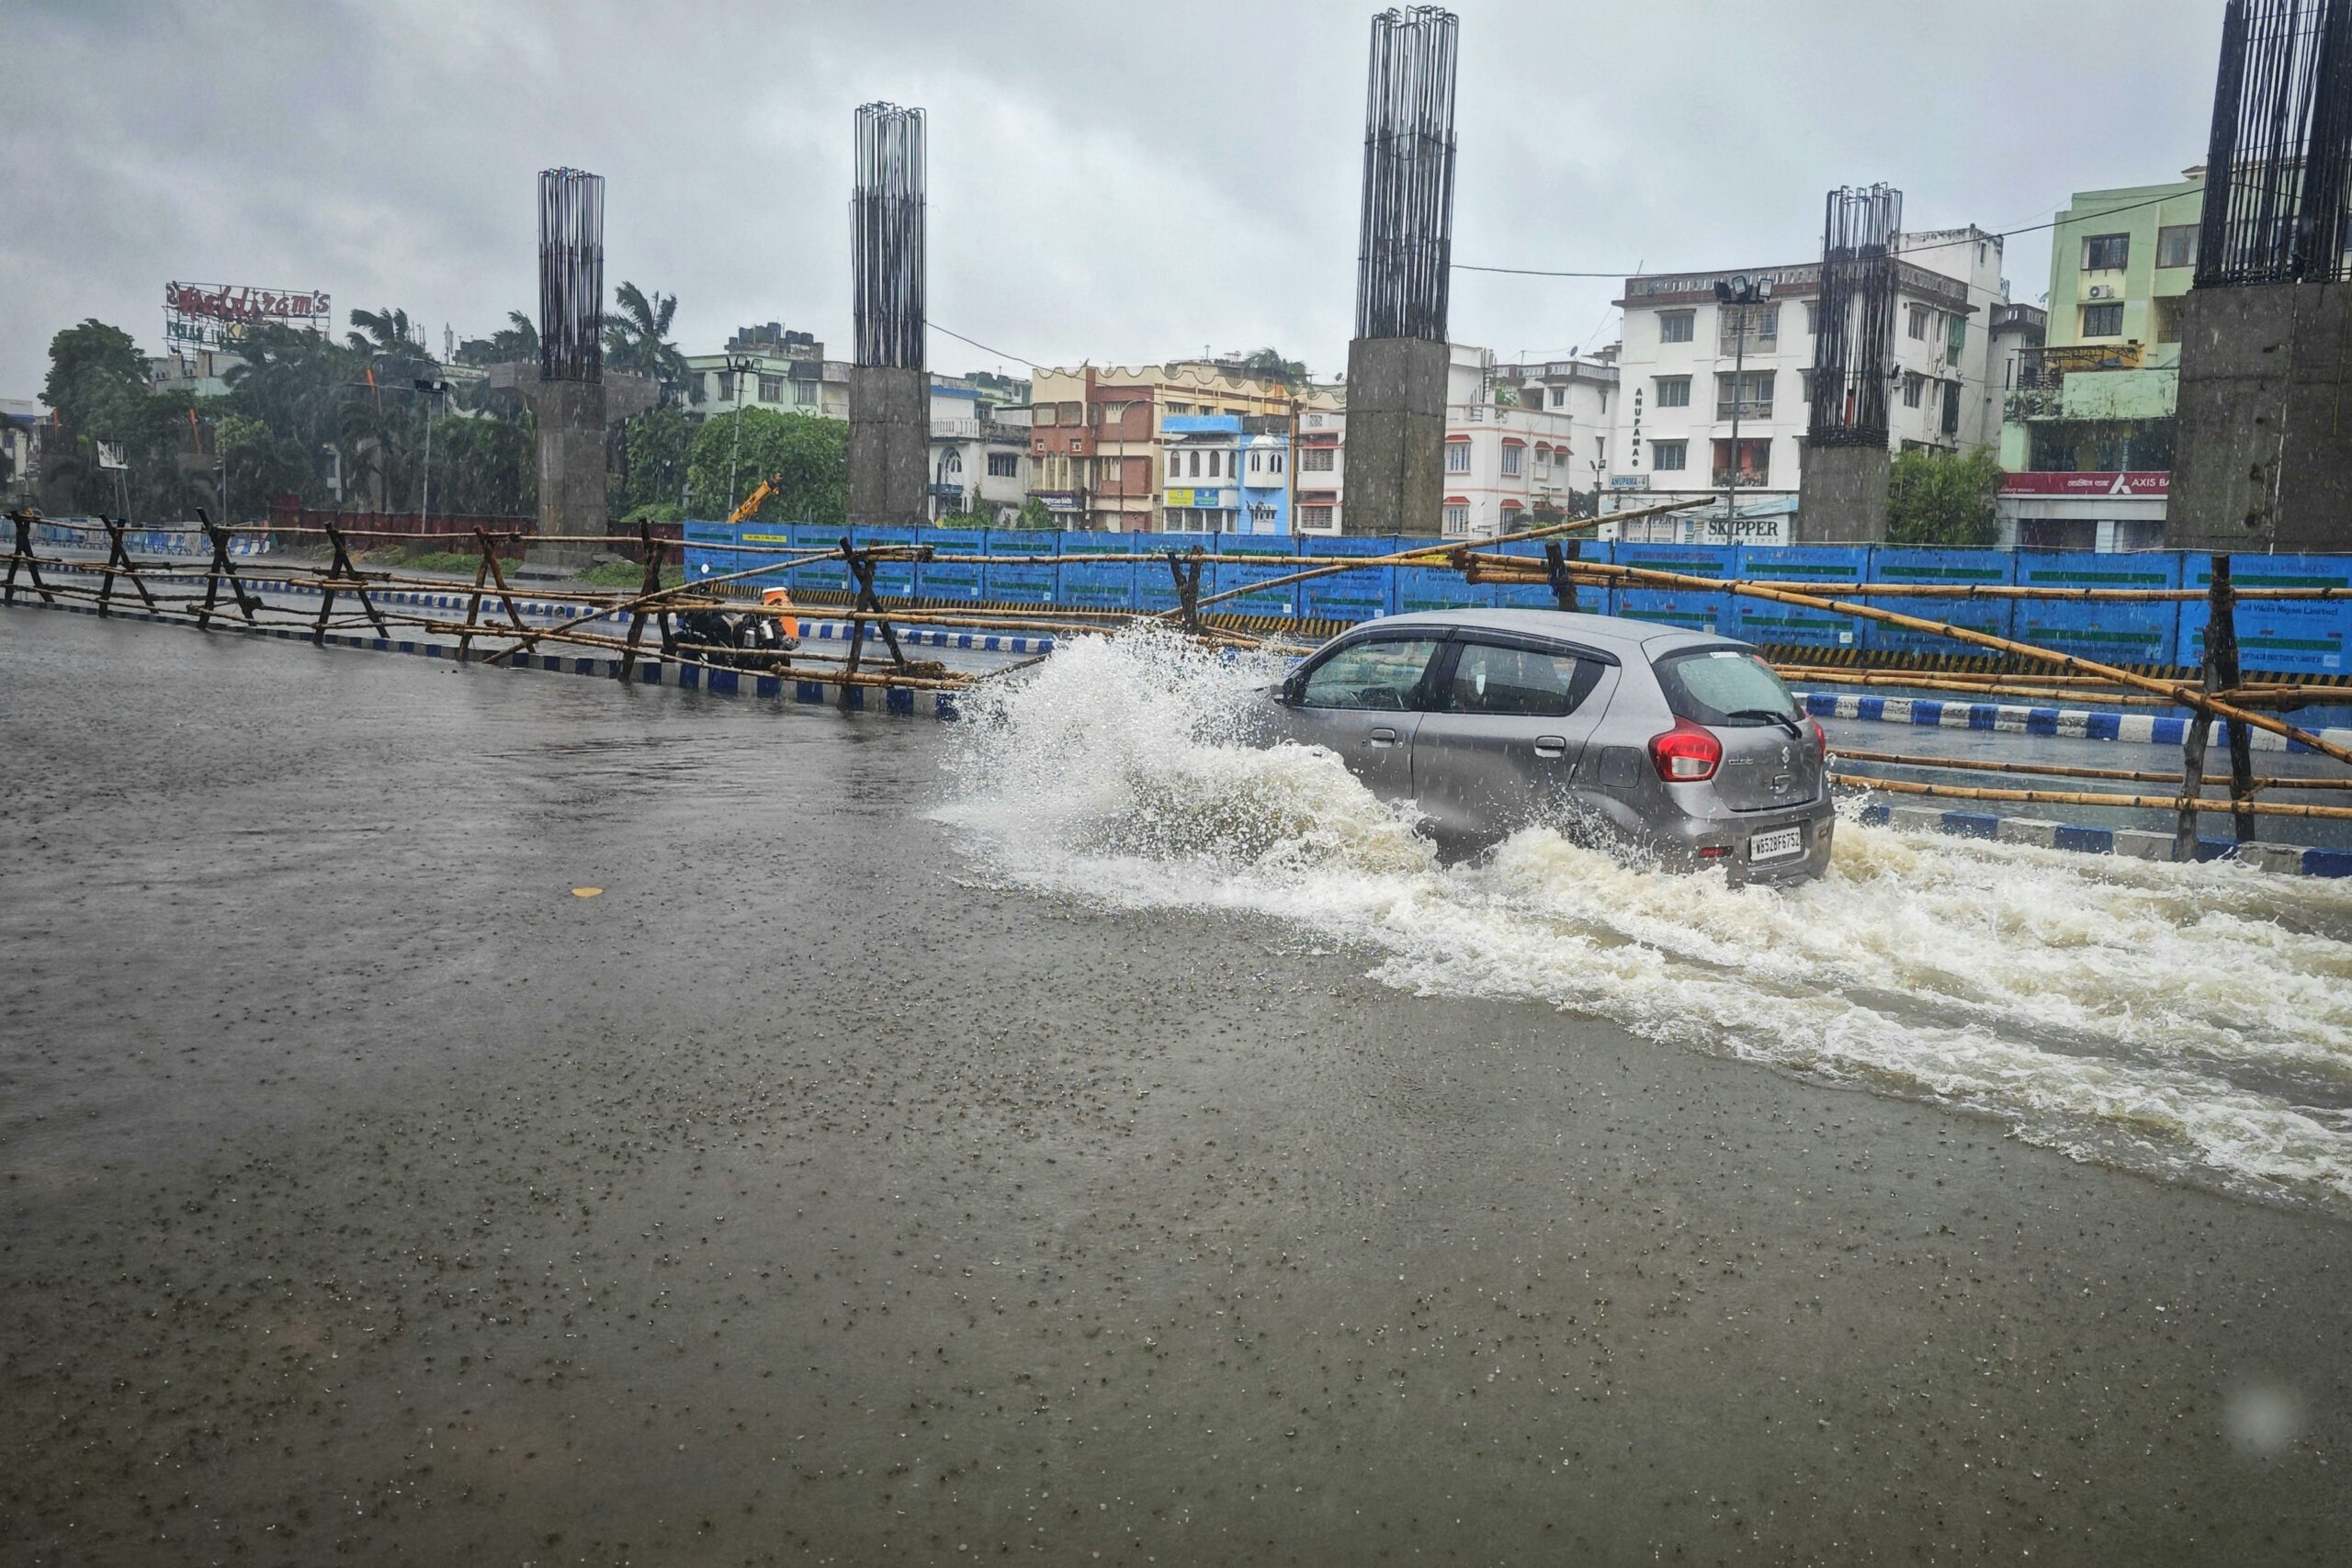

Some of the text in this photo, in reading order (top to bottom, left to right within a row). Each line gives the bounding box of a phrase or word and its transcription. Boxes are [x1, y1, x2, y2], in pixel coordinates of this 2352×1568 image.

[1633, 388, 1643, 457] ANUPAMA
[1611, 477, 1638, 486] ANUPAMA
[2131, 478, 2156, 487] AXIS
[2303, 606, 2338, 615] Limited
